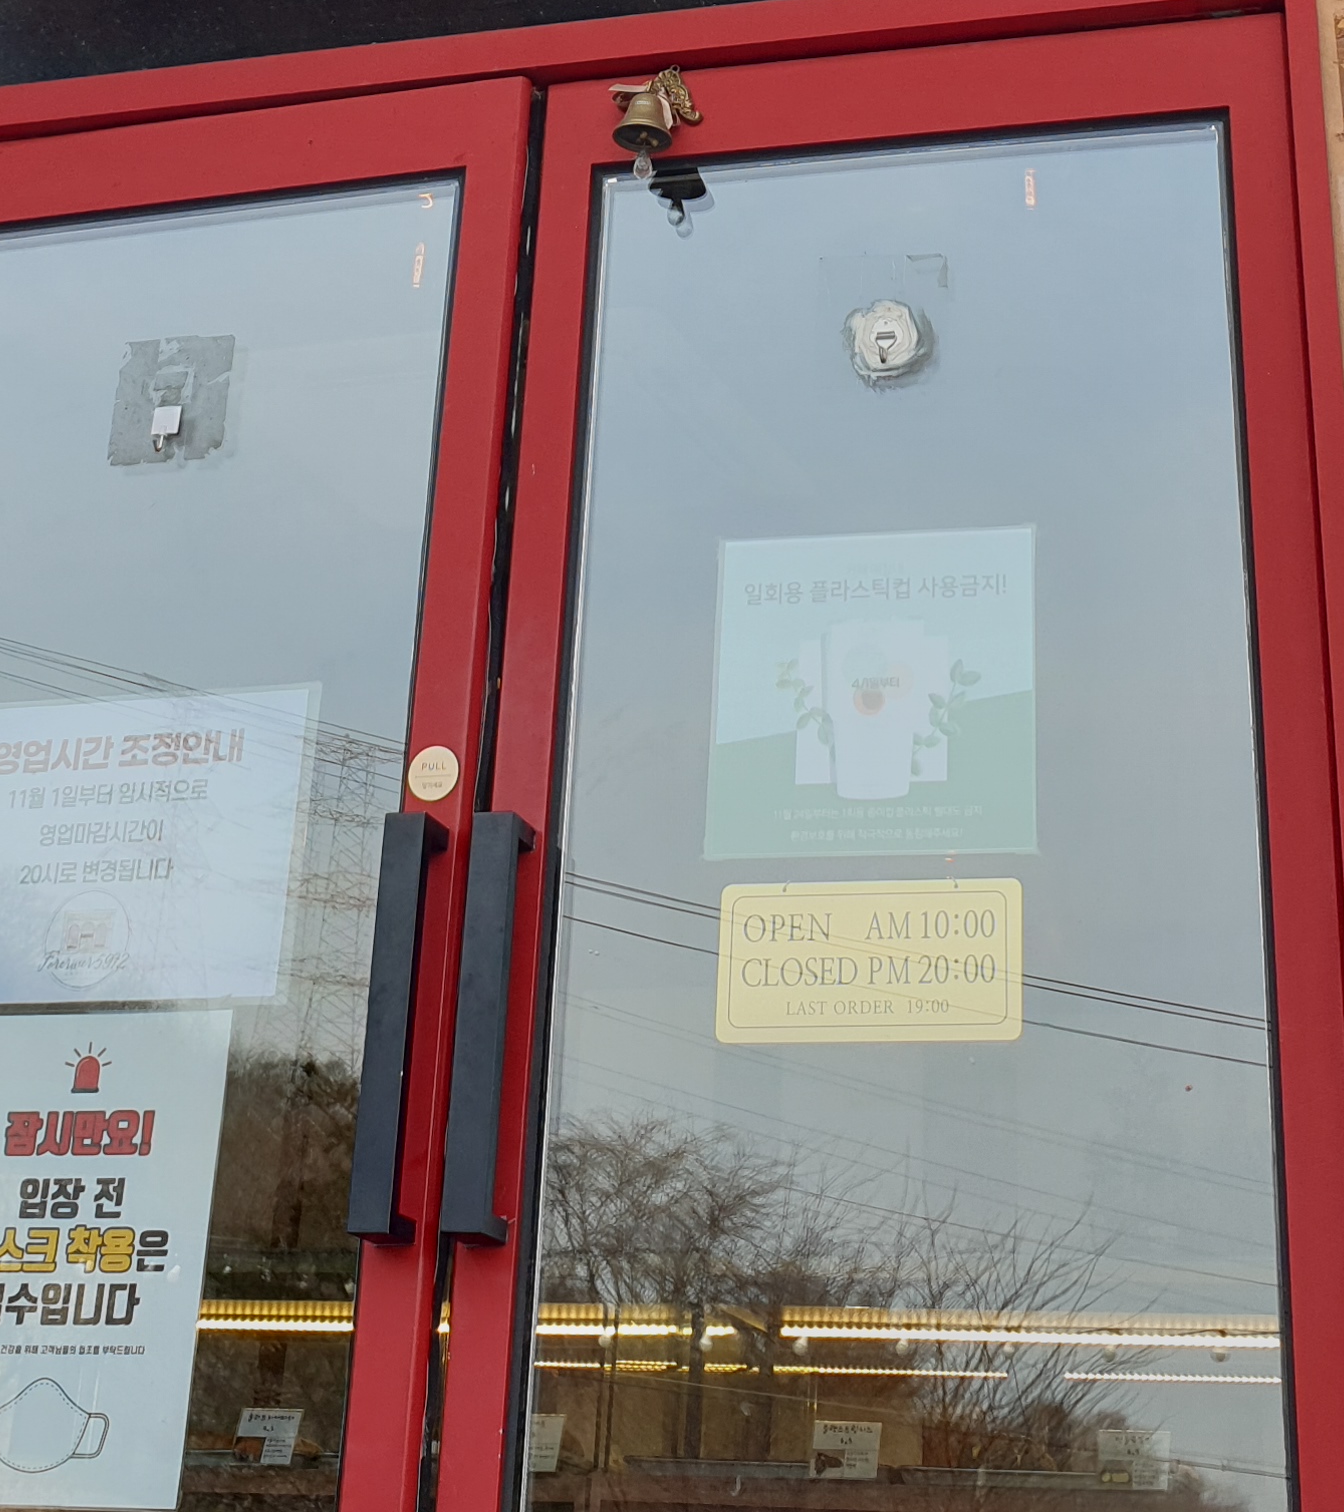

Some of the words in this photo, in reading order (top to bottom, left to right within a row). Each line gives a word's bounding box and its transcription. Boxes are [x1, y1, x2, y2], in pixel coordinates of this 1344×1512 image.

[744, 581, 804, 606] 일회용
[809, 576, 912, 603] 플라스틱컵
[917, 571, 1007, 600] 사용금지!
[118, 728, 245, 768] 조정안내
[421, 760, 447, 771] PULL
[8, 786, 46, 809] 11월
[52, 783, 115, 808] 1일부터
[118, 778, 208, 806] 임시적으로
[39, 818, 164, 848] 영업마감시간이
[19, 861, 78, 885] 20시로
[82, 856, 174, 884] 변경됩니다
[743, 912, 832, 942] OPEN
[865, 910, 911, 940] AM
[921, 909, 996, 939] 10:00
[741, 955, 858, 987] CLOSED
[868, 955, 911, 985] PM
[918, 954, 996, 984] 20:00
[786, 1000, 827, 1016] LAST
[833, 999, 895, 1015] ORDER
[907, 998, 949, 1014] 19:00
[4, 1109, 155, 1156] 잠시만요!
[18, 1177, 85, 1219] 입장
[93, 1177, 126, 1219] 전
[65, 1224, 169, 1273] 착용은
